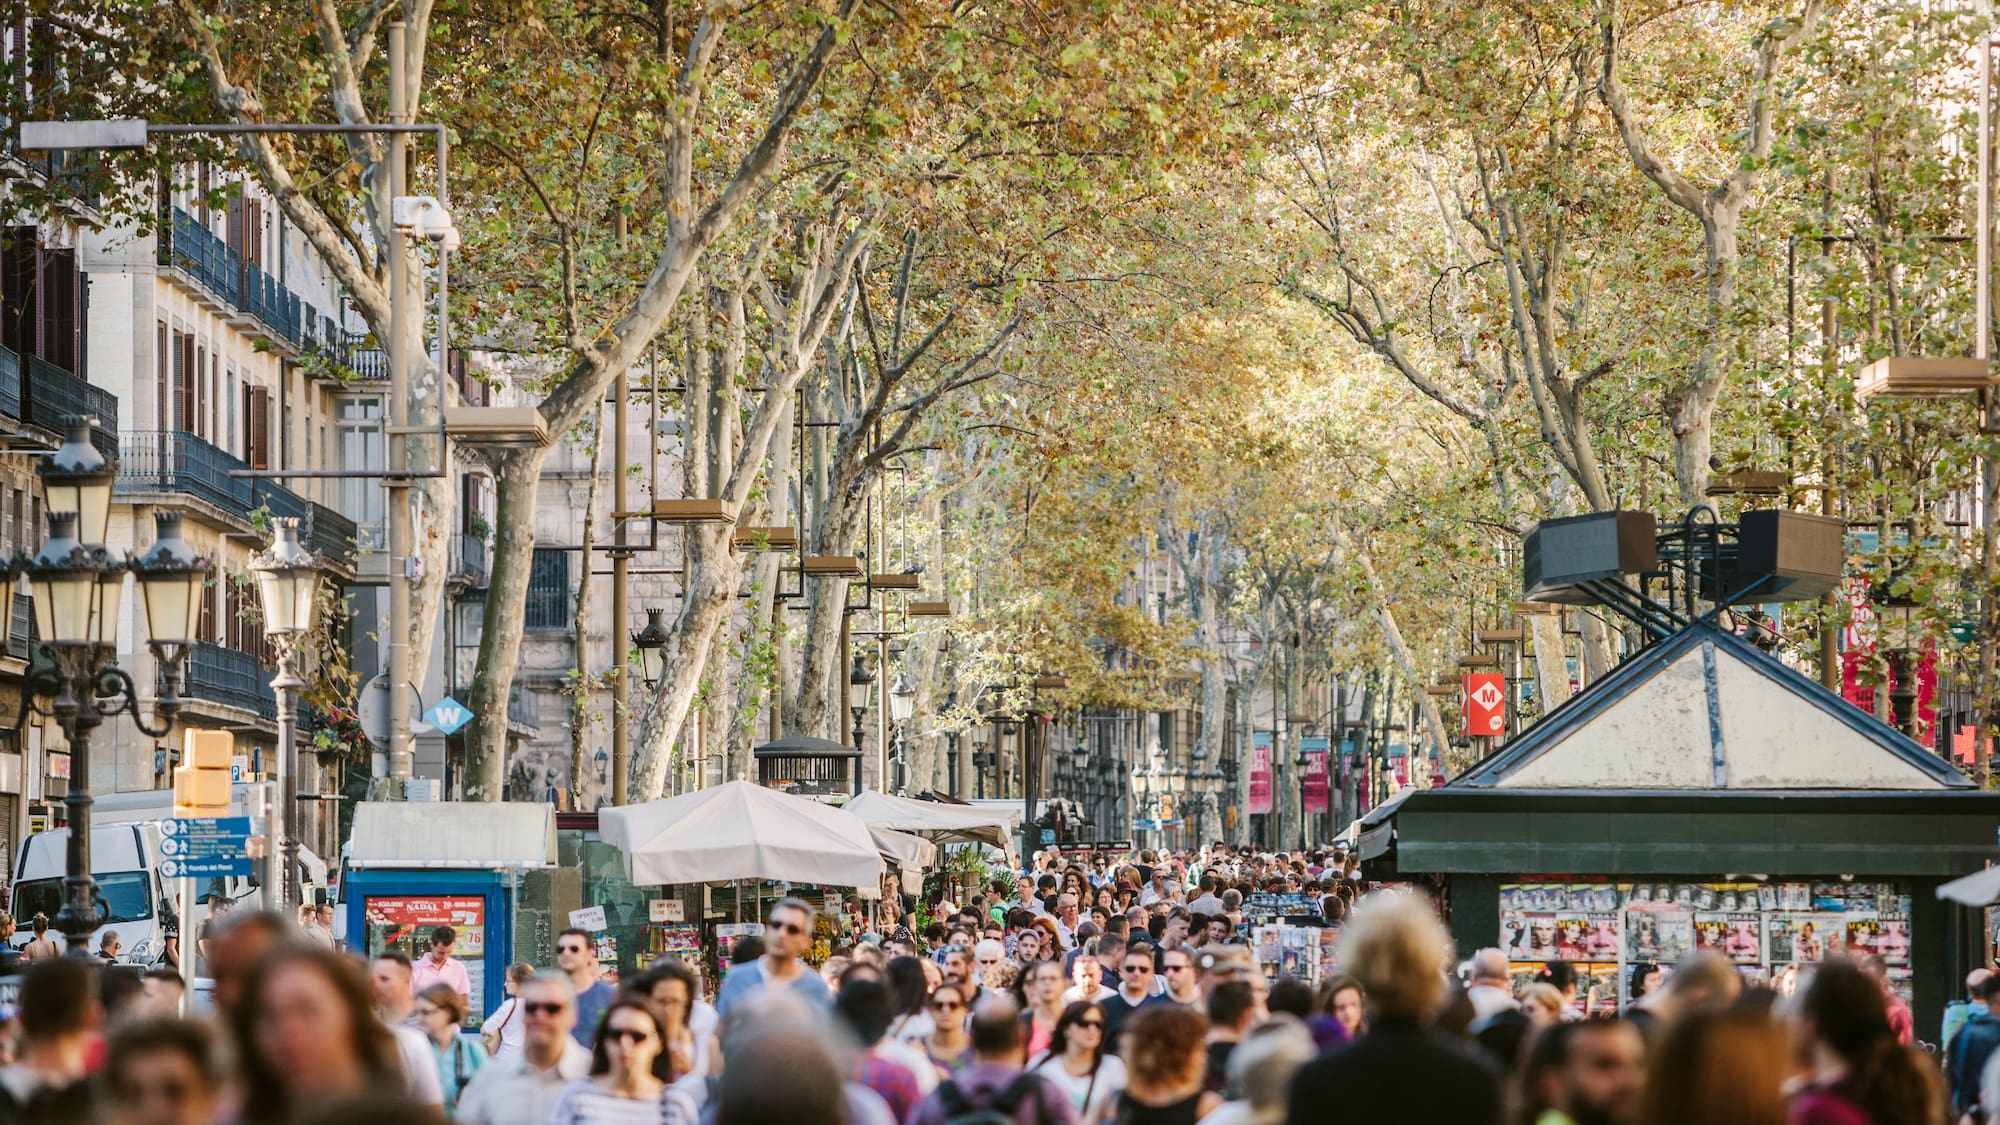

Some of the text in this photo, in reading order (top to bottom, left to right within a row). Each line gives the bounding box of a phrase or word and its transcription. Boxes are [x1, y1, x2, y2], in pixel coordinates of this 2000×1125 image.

[1482, 689, 1495, 703] M
[435, 707, 461, 725] W
[232, 767, 238, 780] P
[406, 902, 439, 911] NADAL
[468, 932, 481, 944] 76
